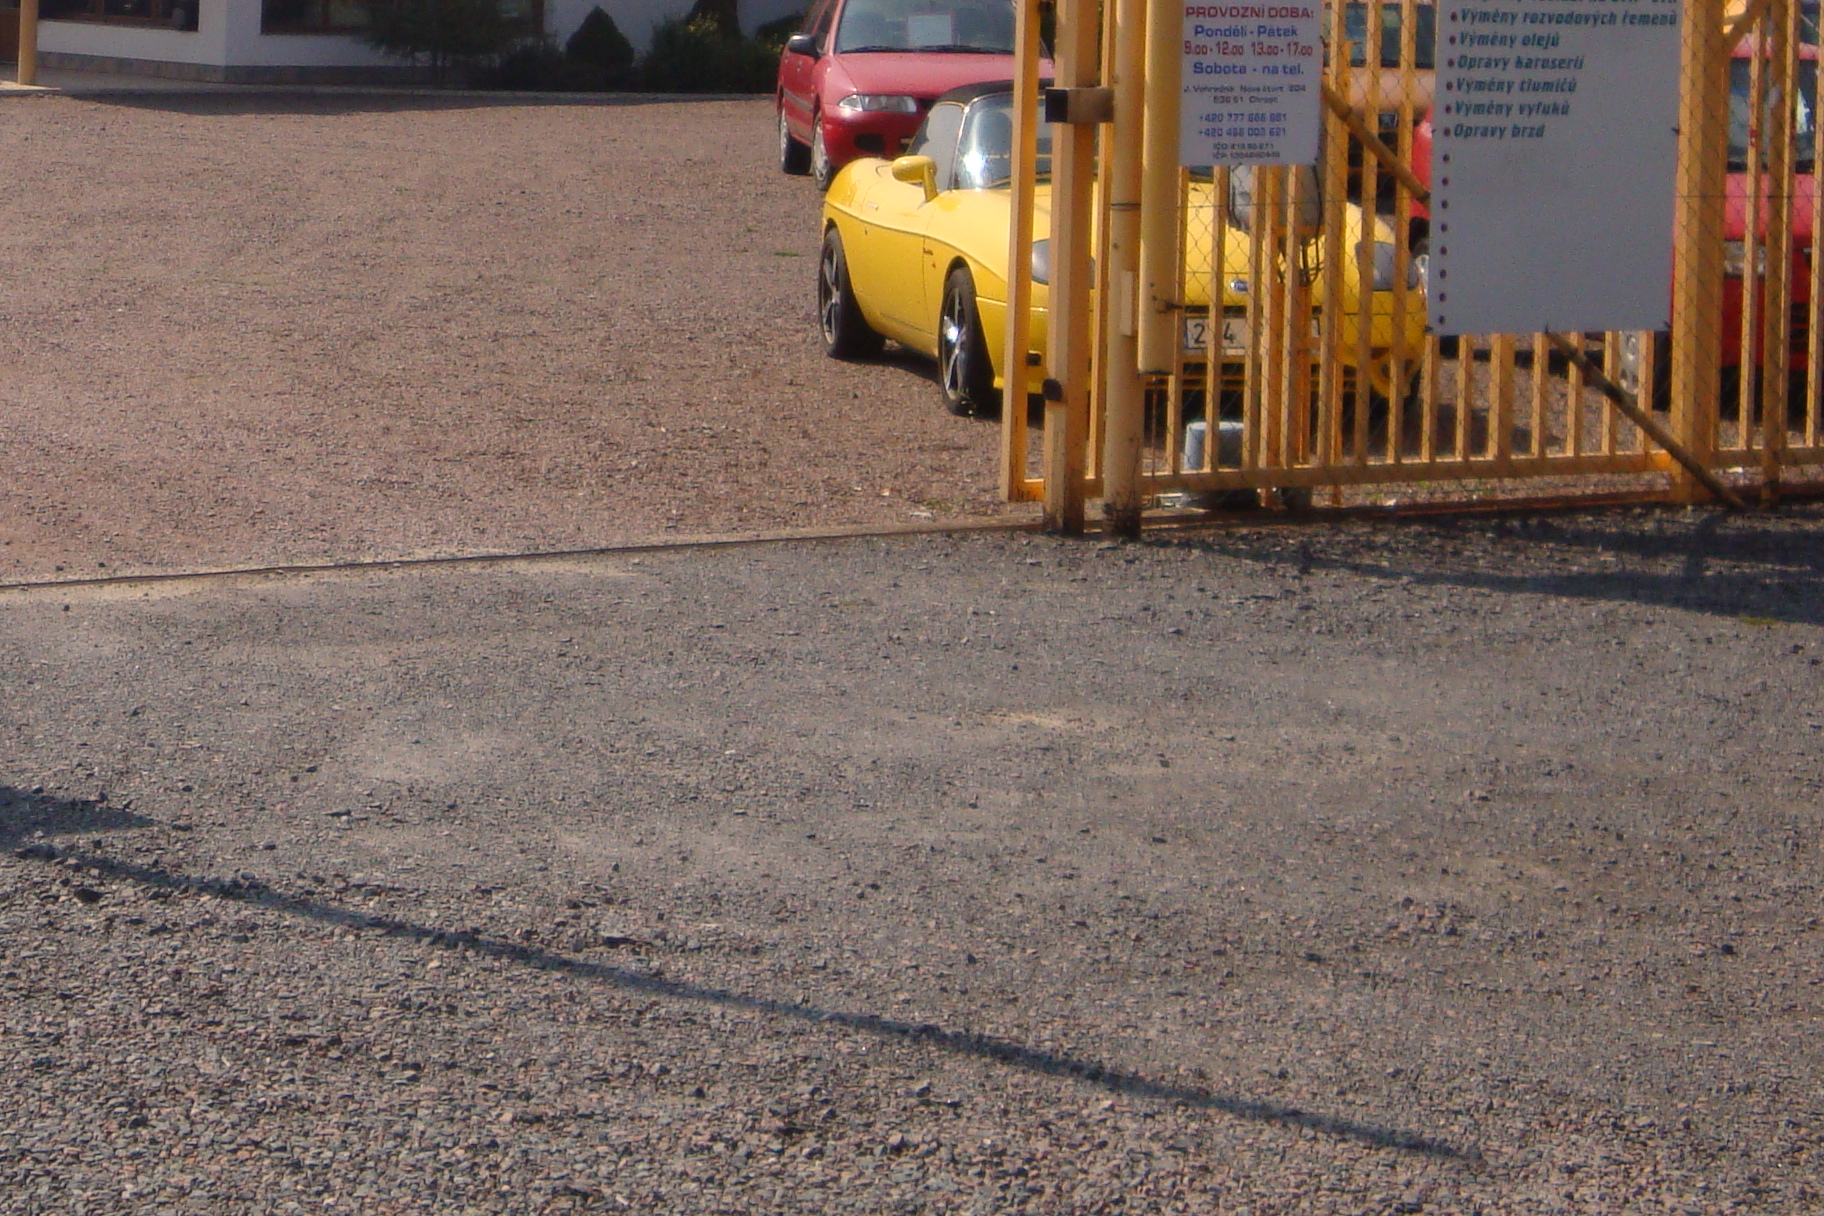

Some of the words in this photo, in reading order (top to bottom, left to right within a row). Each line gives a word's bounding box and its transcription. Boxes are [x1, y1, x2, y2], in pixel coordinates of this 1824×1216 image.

[1186, 4, 1265, 18] PROVOZNÍ
[1268, 7, 1314, 18] DOBA:
[1194, 25, 1247, 37] Pondělí
[1257, 25, 1298, 37] Pátek
[1216, 41, 1244, 55] 12.00
[1251, 41, 1278, 56] 13.00
[1287, 42, 1313, 56] 17.00
[1282, 64, 1304, 75] tel.
[1458, 55, 1510, 71] Opravy
[1454, 123, 1506, 139] Opravy
[1511, 123, 1545, 138] brzd
